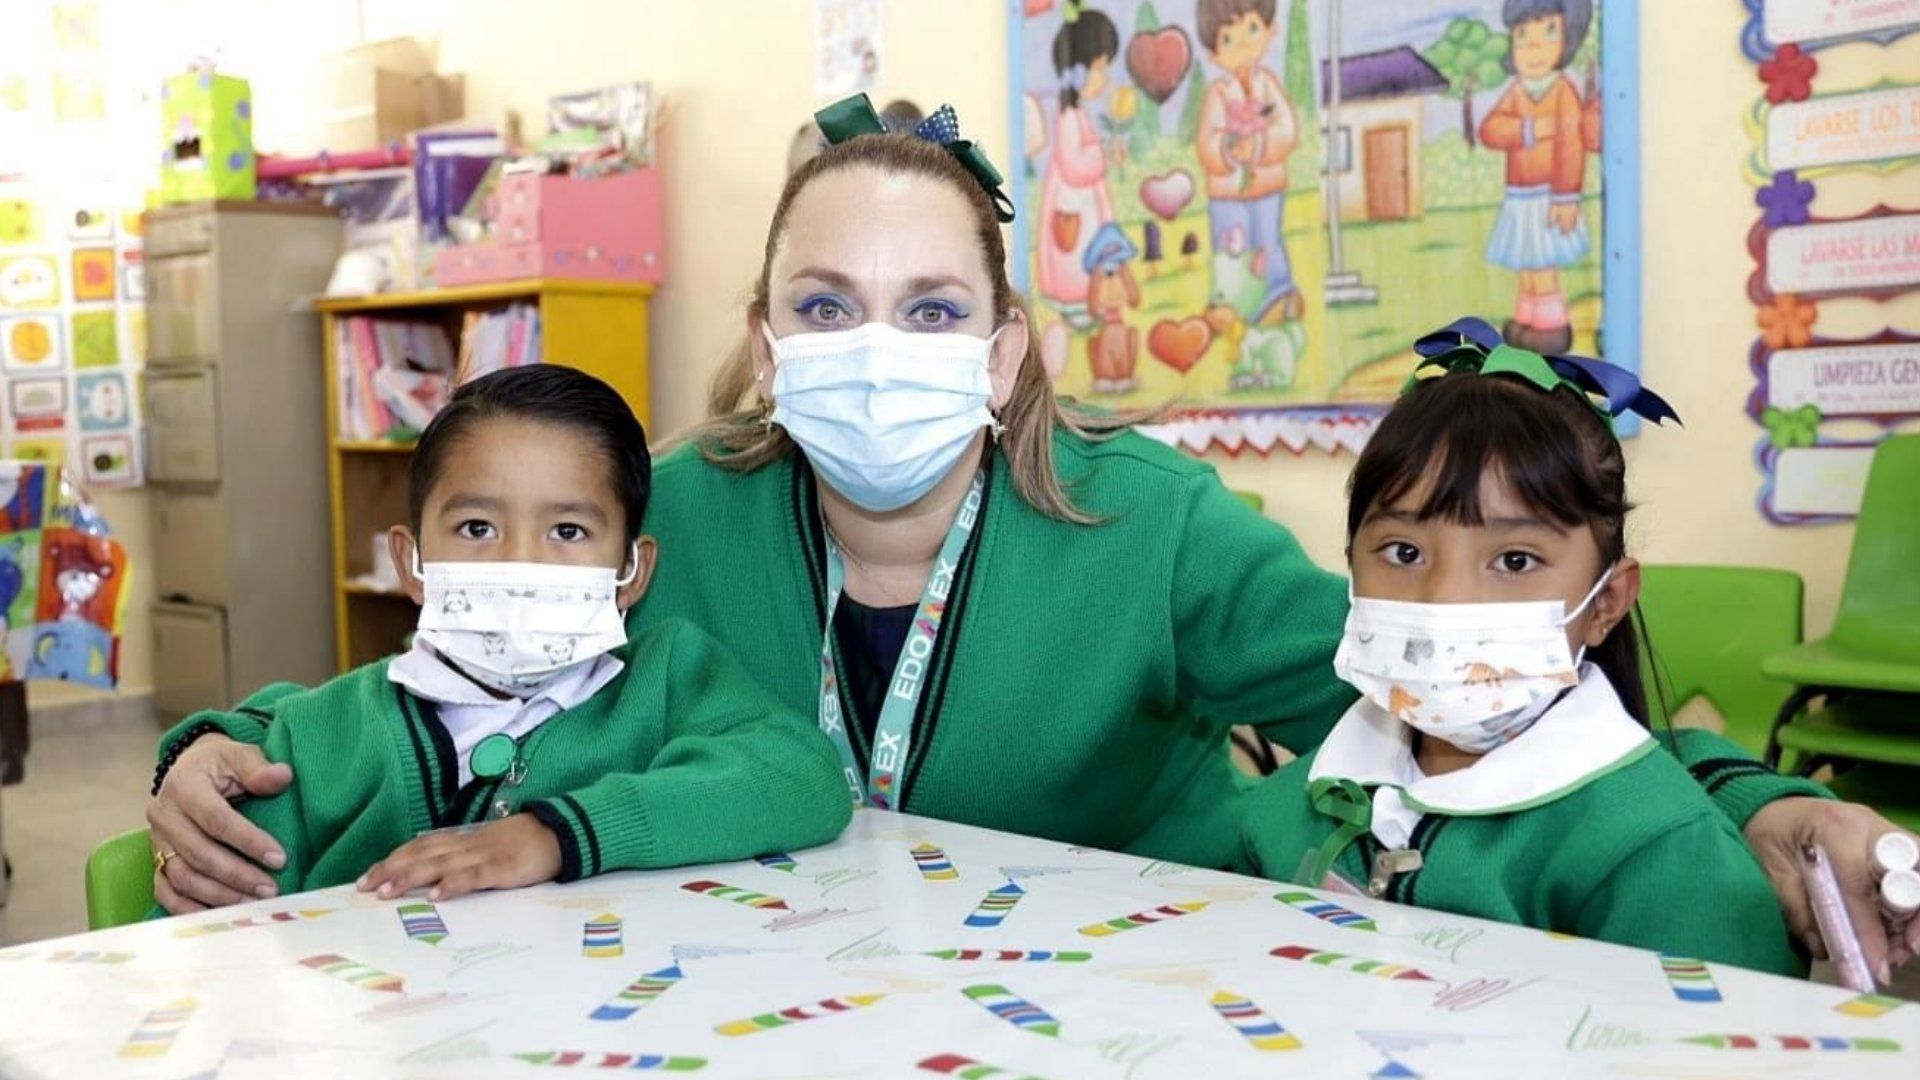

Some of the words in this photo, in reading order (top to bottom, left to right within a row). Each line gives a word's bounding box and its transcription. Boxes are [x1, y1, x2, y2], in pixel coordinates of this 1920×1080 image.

[1802, 234, 1865, 264] LAVARSE
[1813, 360, 1886, 388] LIMPIEZA
[1889, 357, 1920, 386] GEN
